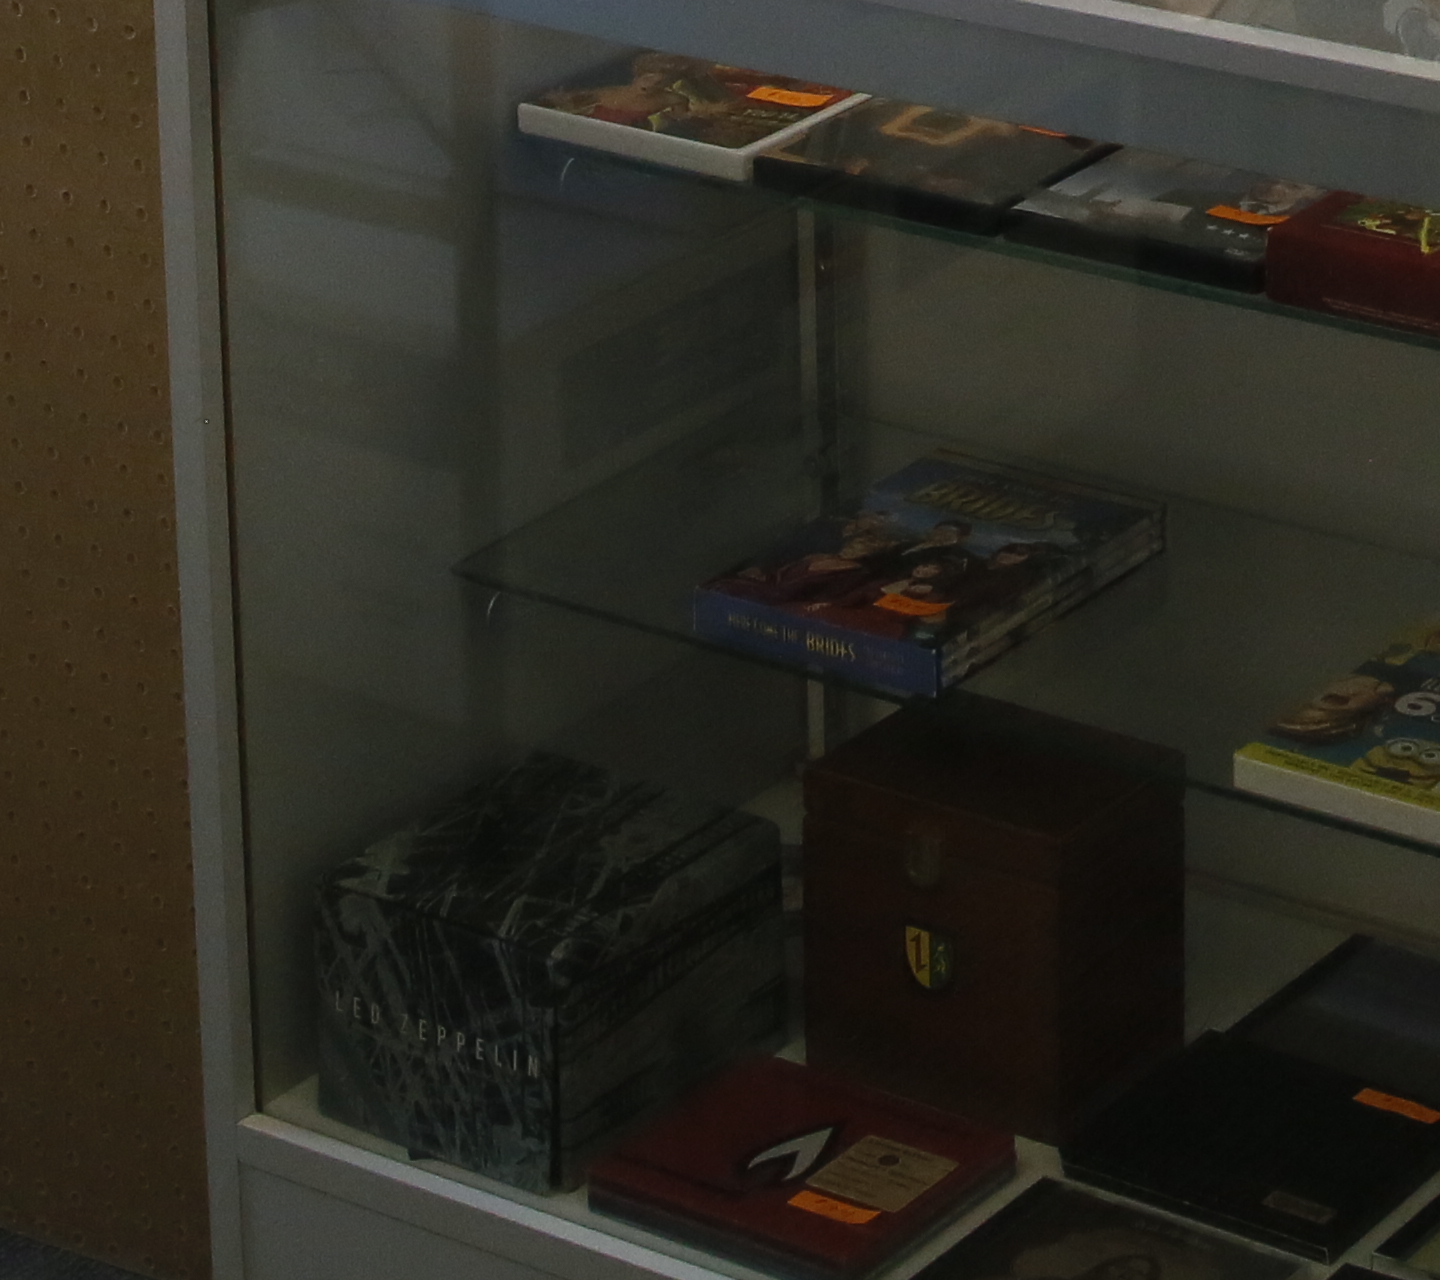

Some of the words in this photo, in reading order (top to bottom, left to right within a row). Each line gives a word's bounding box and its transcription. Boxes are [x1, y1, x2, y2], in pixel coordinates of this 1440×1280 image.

[805, 632, 857, 663] BRIDES
[334, 989, 380, 1025] LED
[399, 1013, 540, 1079] ZEPPELIN
